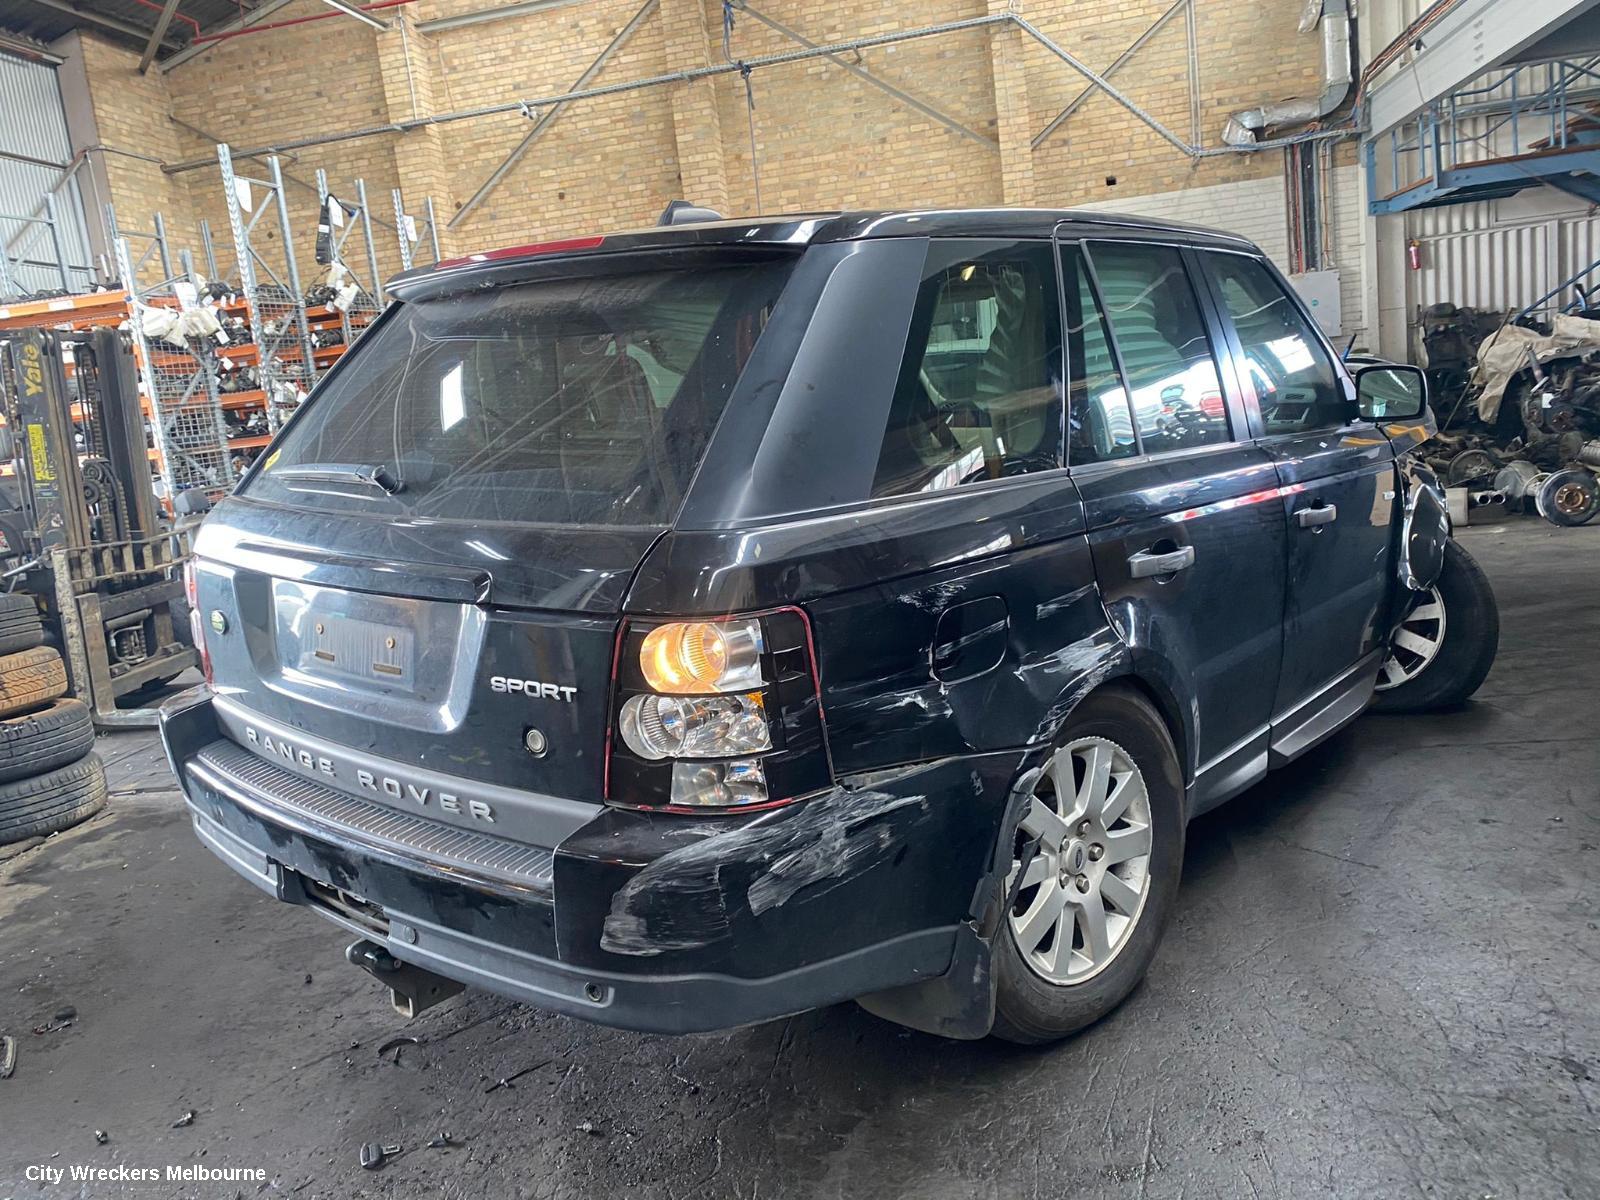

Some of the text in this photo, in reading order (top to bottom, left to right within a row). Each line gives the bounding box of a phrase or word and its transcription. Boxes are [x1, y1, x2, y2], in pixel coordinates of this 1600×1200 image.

[22, 344, 43, 396] Yale
[490, 676, 578, 703] SPORT
[245, 726, 496, 824] RANGE ROVER
